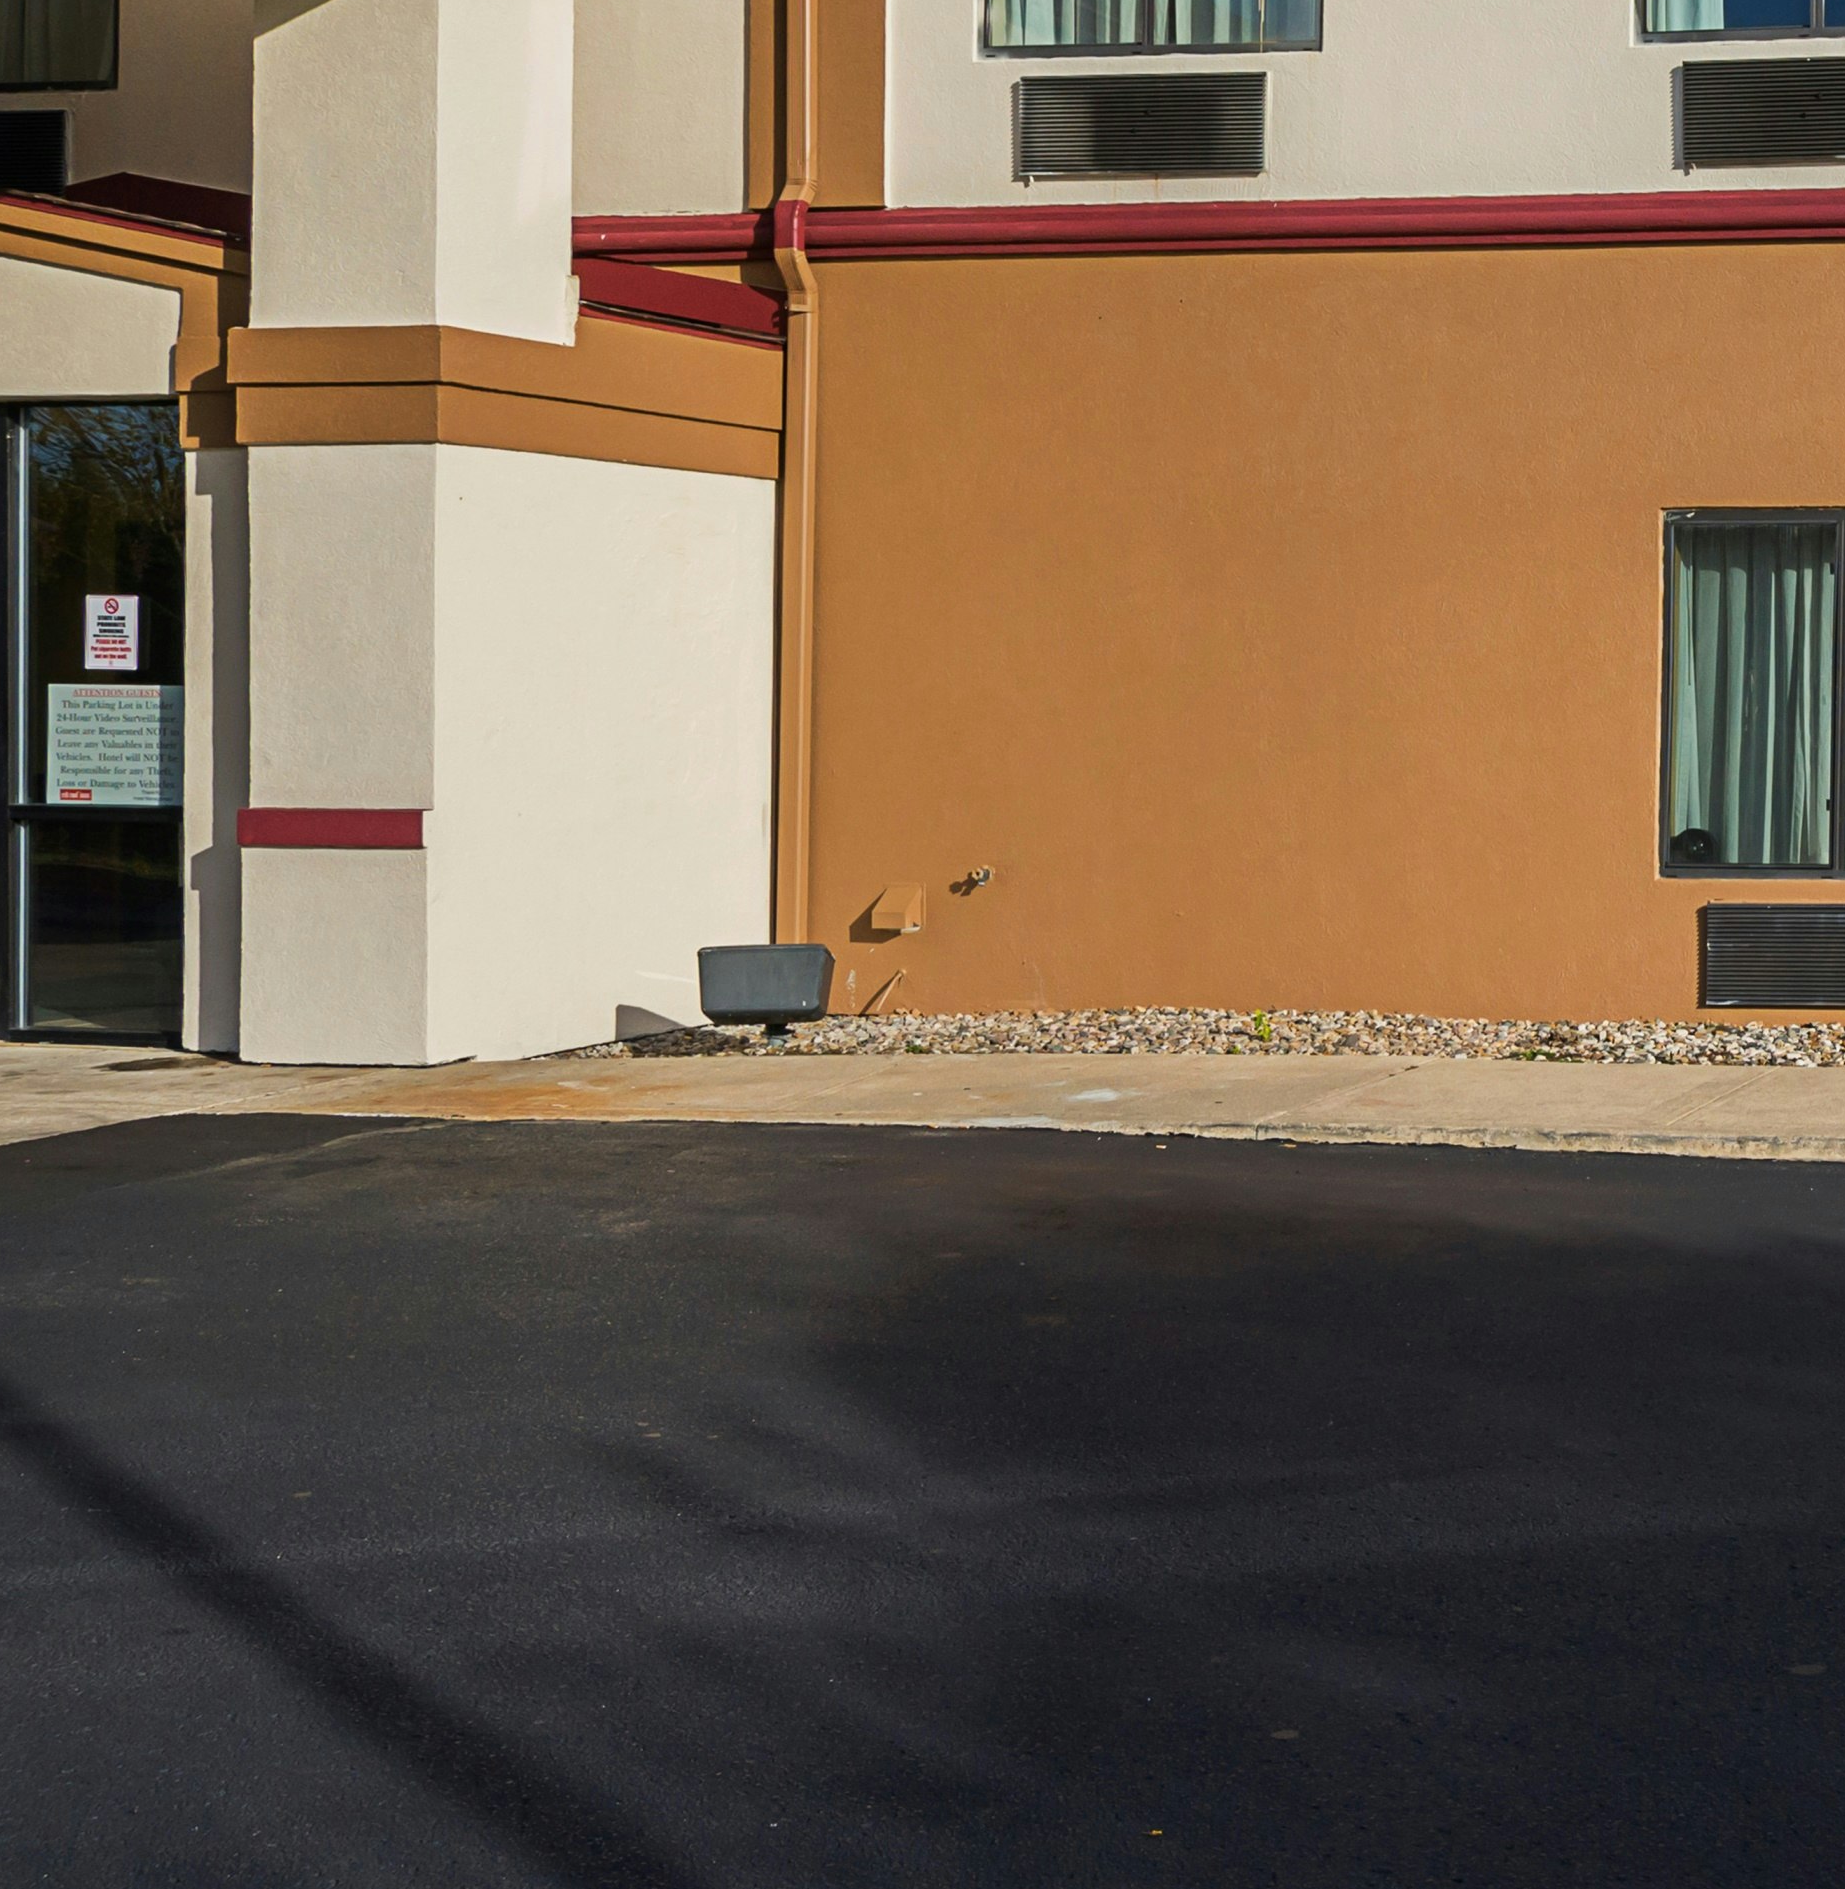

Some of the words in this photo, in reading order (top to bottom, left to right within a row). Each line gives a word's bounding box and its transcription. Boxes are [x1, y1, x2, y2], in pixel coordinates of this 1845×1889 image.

[61, 701, 80, 709] This
[83, 701, 115, 710] Parking
[118, 701, 133, 709] Lot
[94, 714, 120, 722] Video
[99, 728, 143, 737] Requested
[101, 740, 142, 748] Valuables
[98, 753, 123, 761] Hotel
[60, 766, 111, 776] Responsible
[57, 779, 75, 787] Loss
[90, 779, 124, 789] Damage
